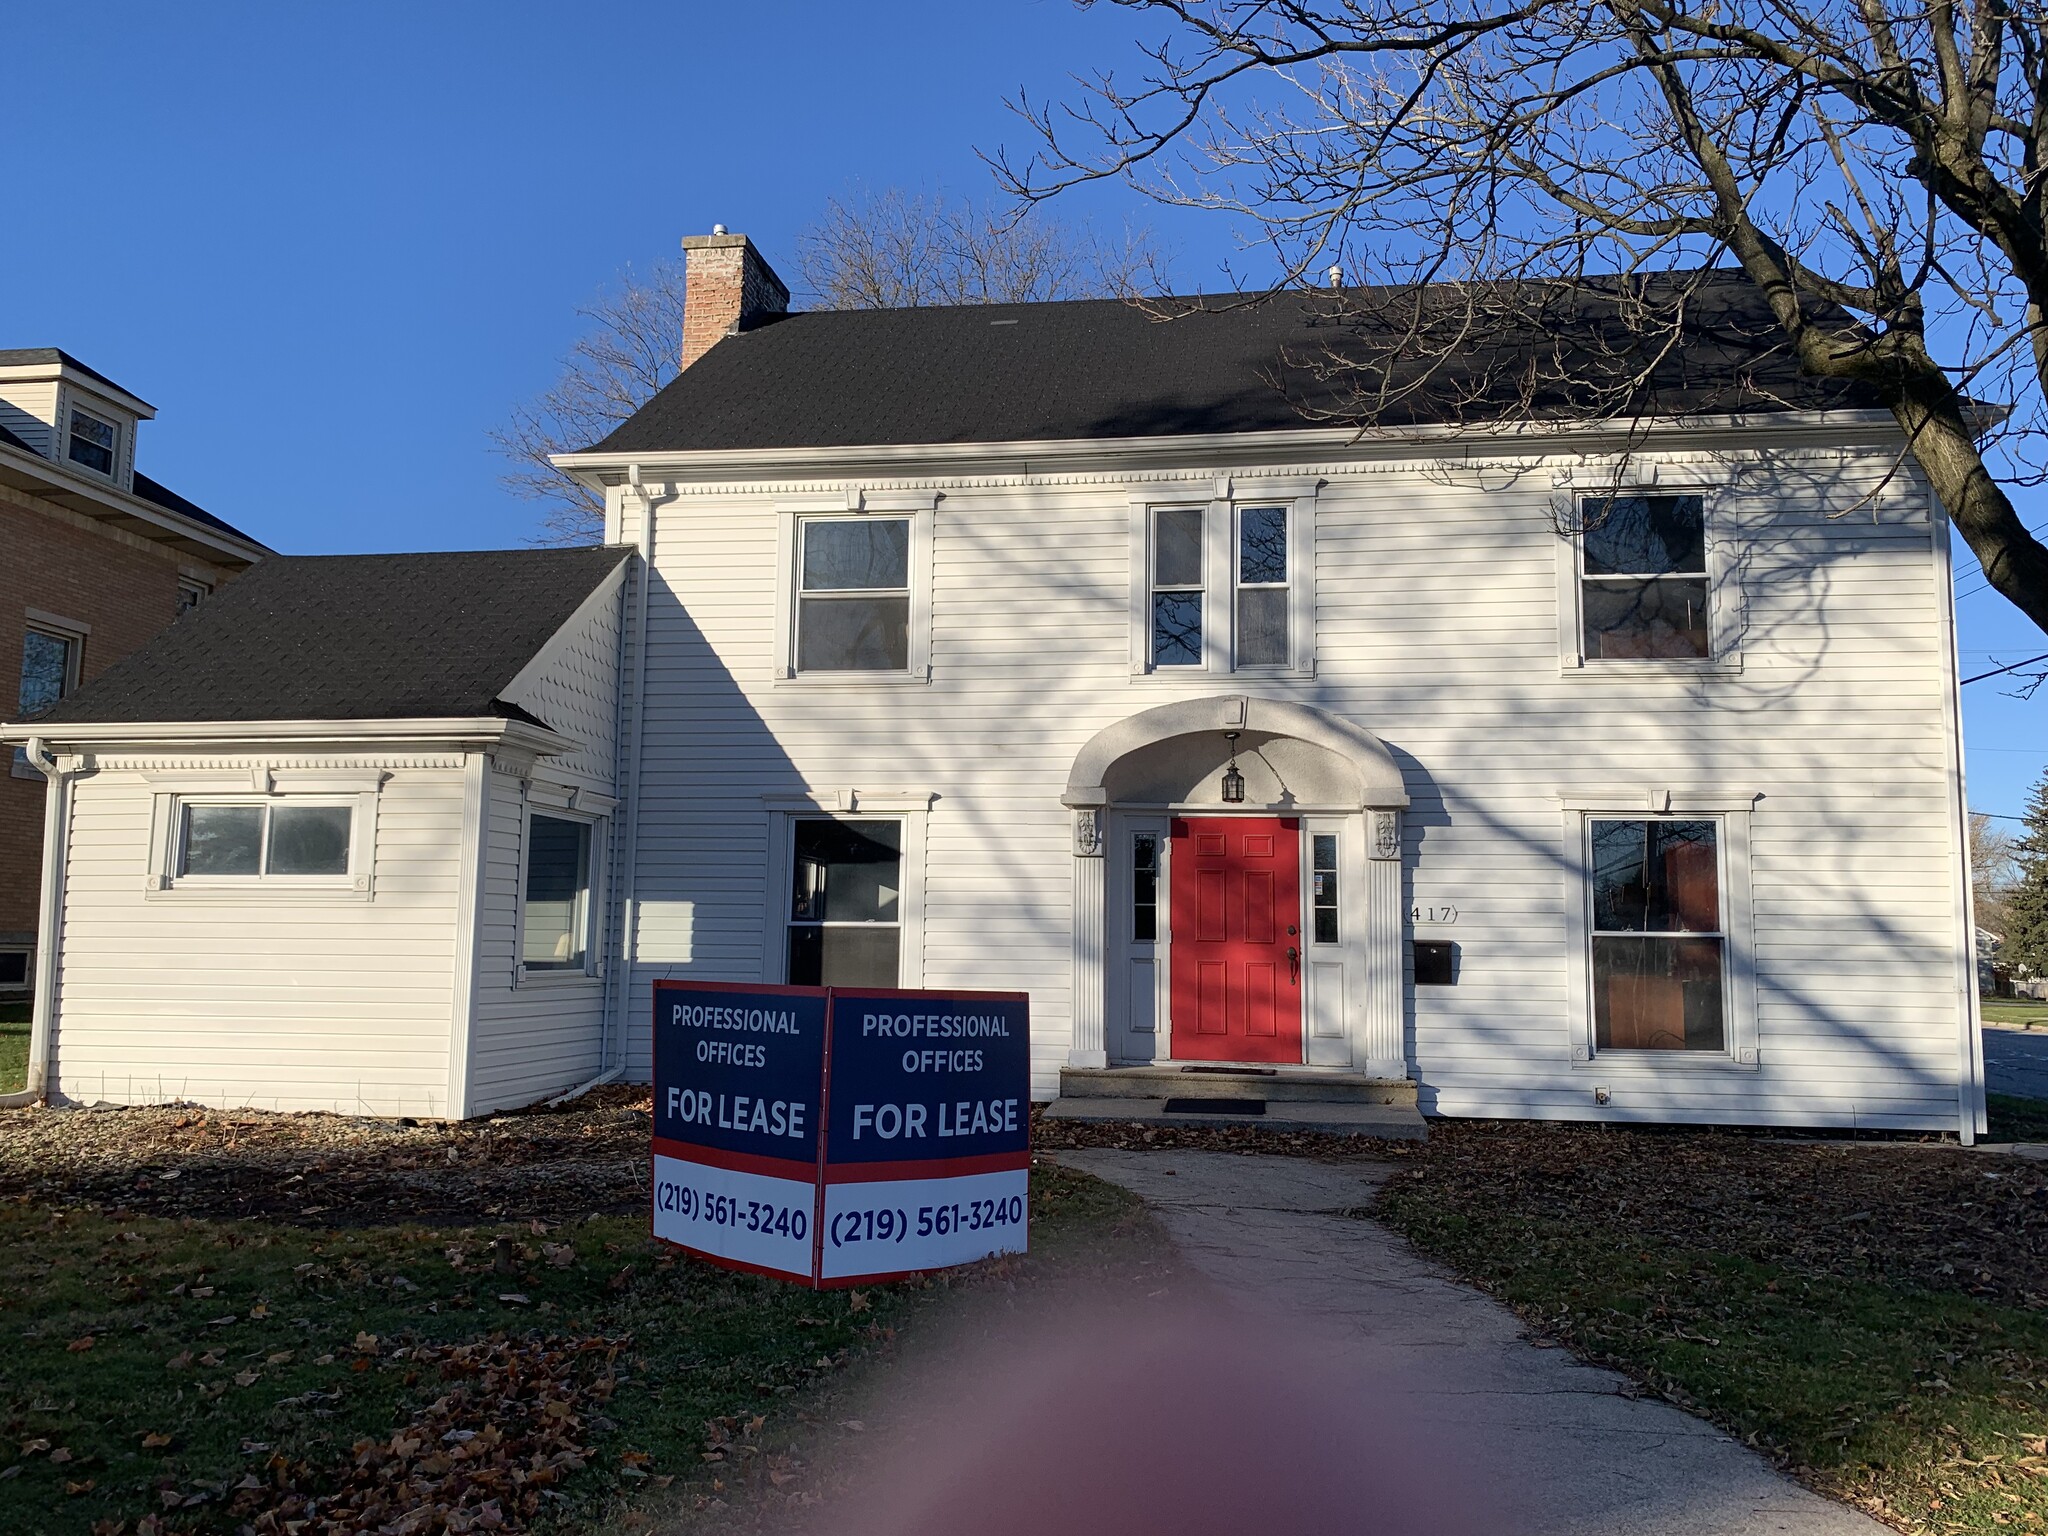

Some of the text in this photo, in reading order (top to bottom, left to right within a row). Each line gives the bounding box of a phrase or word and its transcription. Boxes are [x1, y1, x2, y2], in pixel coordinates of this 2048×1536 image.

[1411, 907, 1451, 921] 417
[672, 1004, 800, 1035] PROFESSIONAL
[862, 1014, 1010, 1038] PROFESSIONAL
[697, 1040, 766, 1068] OFFICES
[902, 1050, 983, 1073] OFFICES
[667, 1086, 806, 1138] FOR LEASE
[853, 1098, 1018, 1140] FOR LEASE
[658, 1180, 807, 1241] (219) 561-3240
[831, 1196, 1022, 1248] (219) 561-3240
